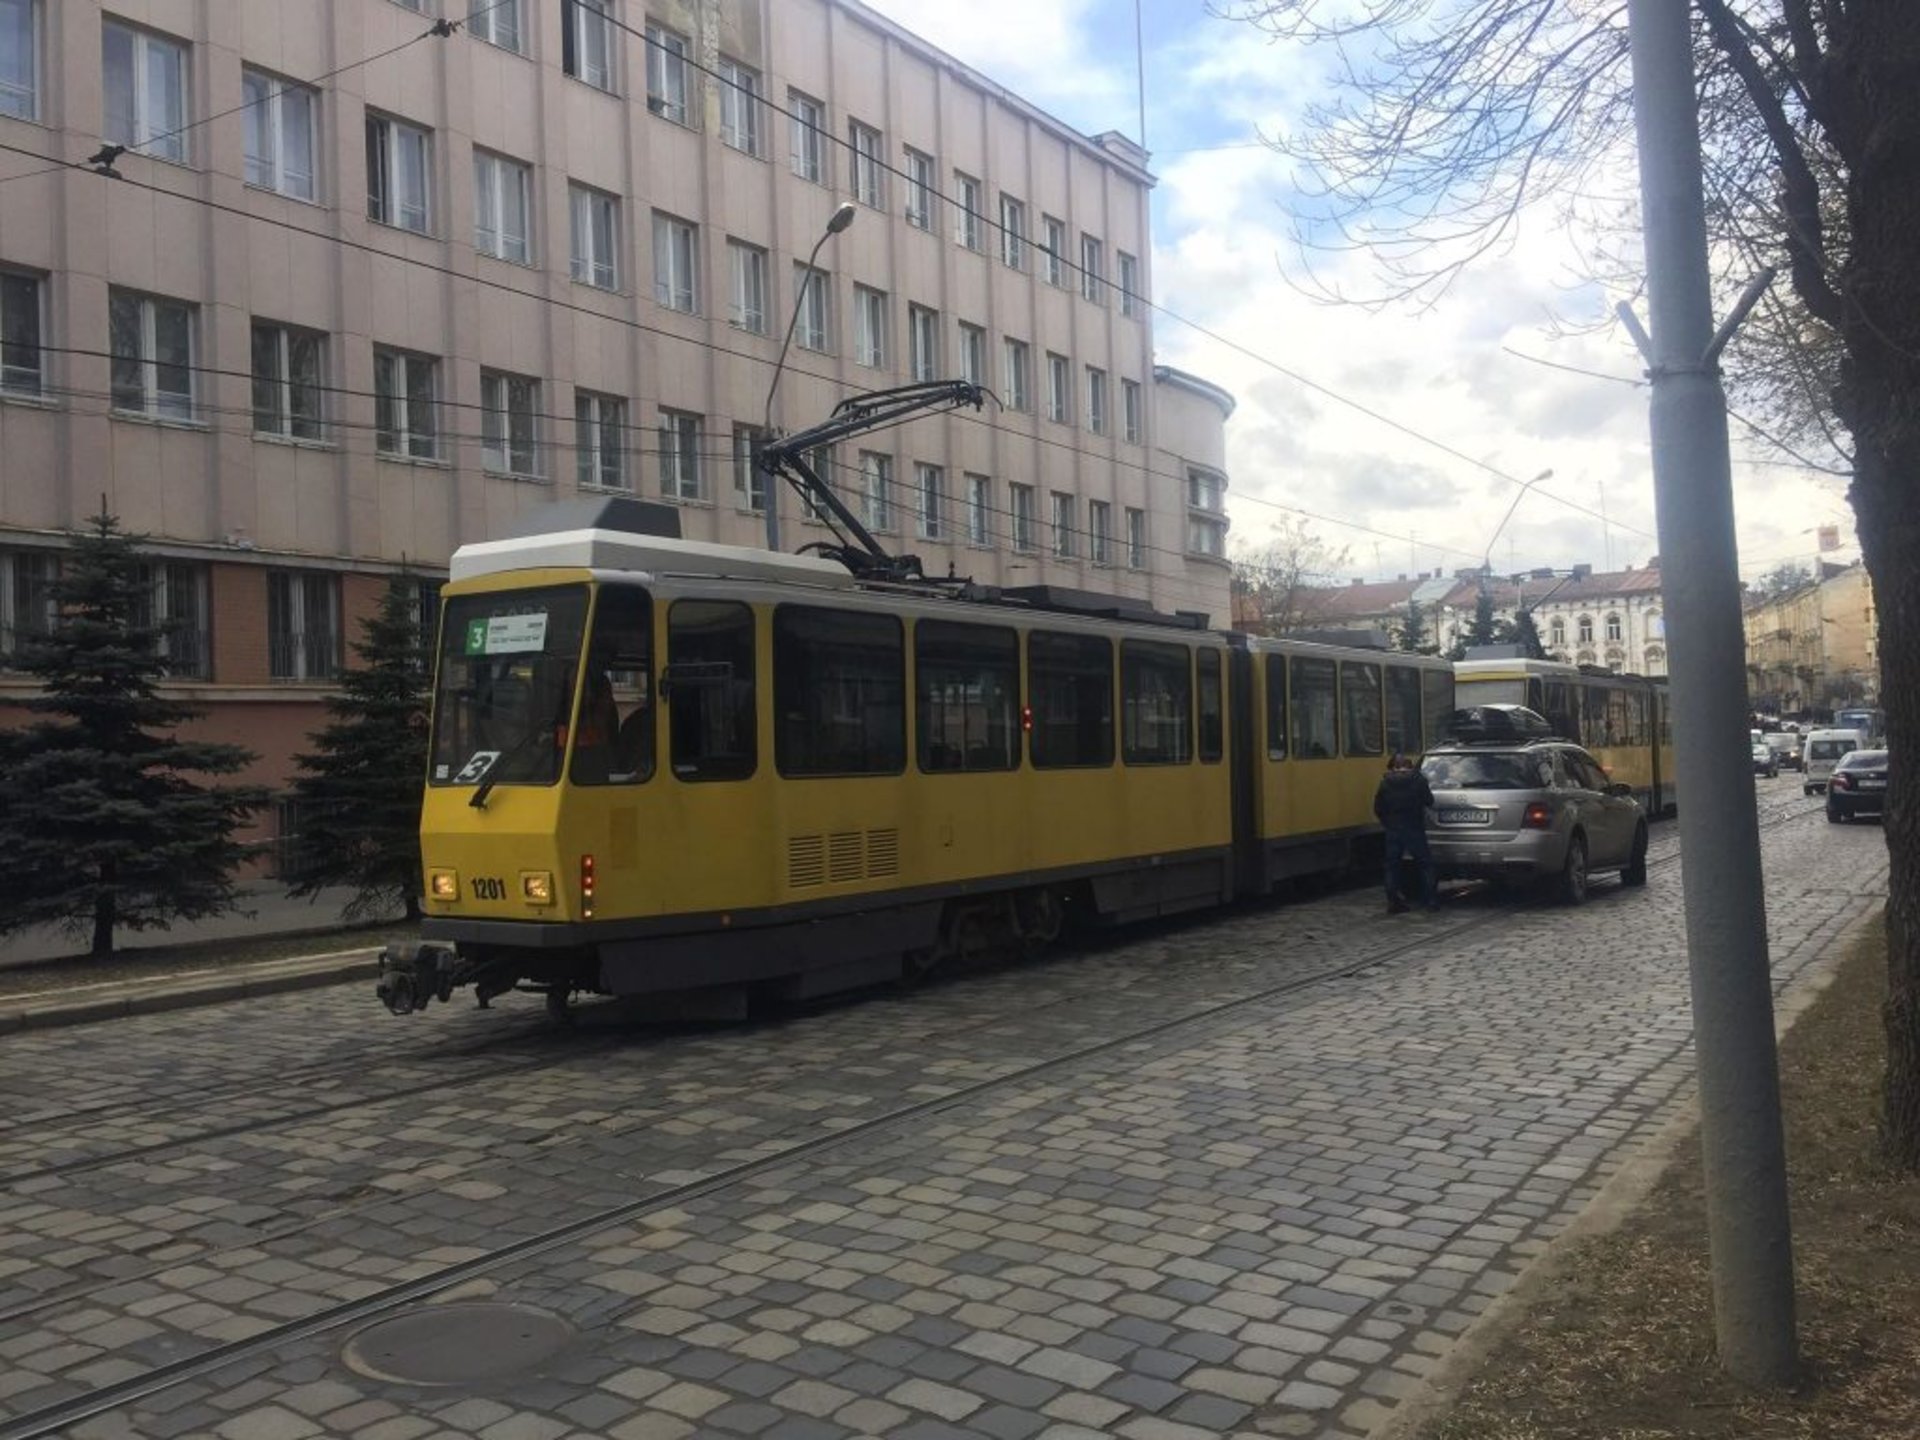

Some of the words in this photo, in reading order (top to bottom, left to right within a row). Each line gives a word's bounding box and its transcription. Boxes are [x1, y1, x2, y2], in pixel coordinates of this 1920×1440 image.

[471, 627, 483, 648] 3
[456, 755, 492, 782] 3
[471, 878, 507, 900] 1201
